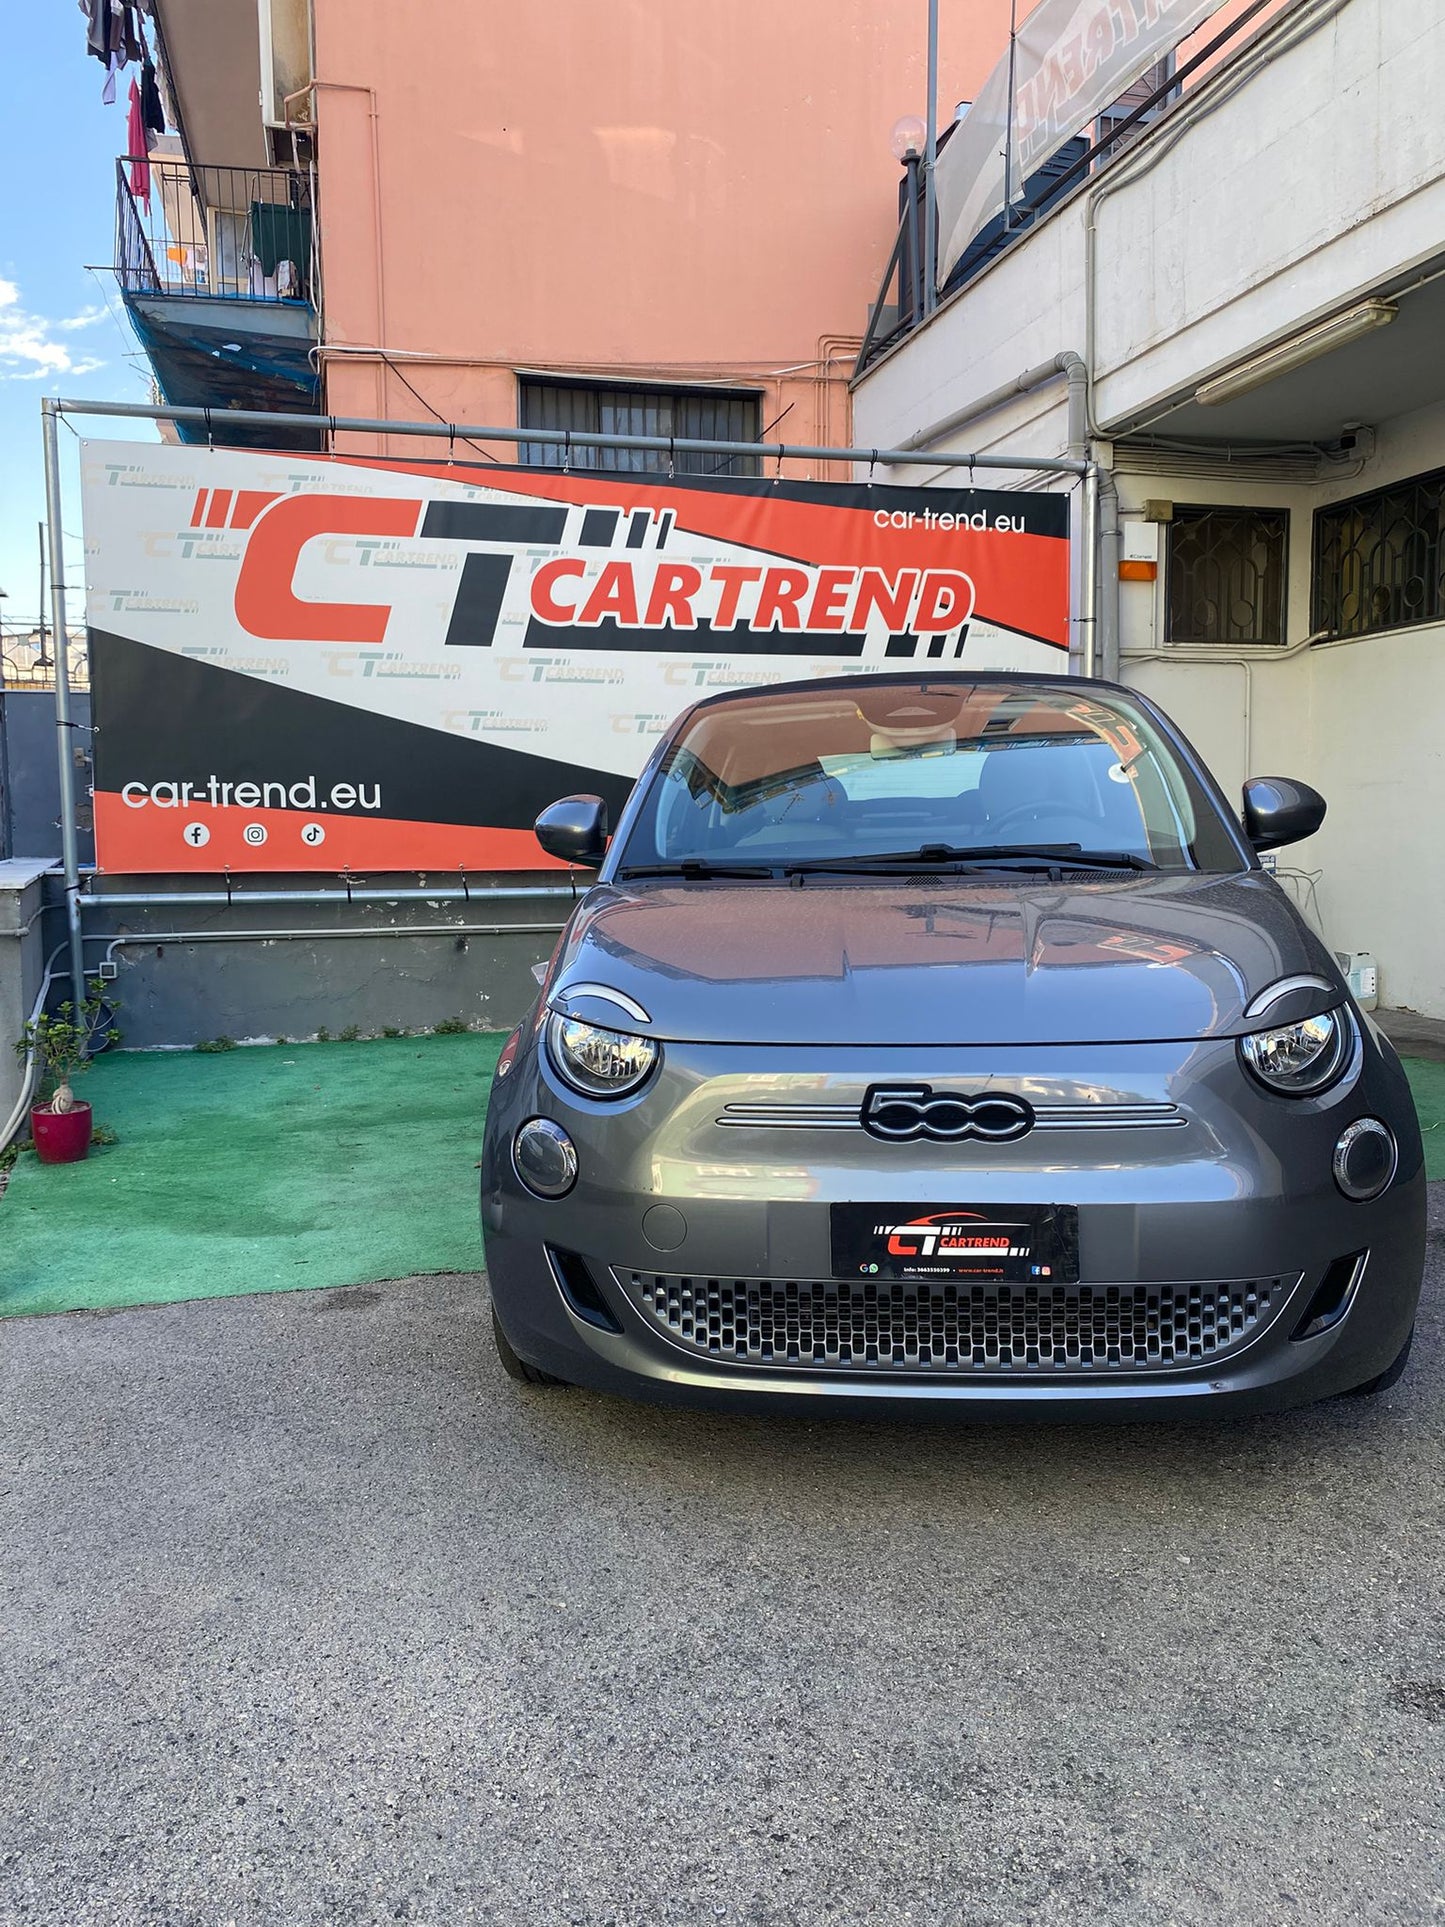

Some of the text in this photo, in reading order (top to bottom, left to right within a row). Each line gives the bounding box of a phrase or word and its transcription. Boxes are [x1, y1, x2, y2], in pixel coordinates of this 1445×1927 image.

[873, 507, 1026, 534] car-trend.eu
[374, 551, 458, 564] CARTREND
[530, 558, 974, 632] CARTREND
[376, 661, 461, 675] CARTREND
[546, 666, 624, 680] CARTREND
[708, 671, 782, 683] CARTREND
[121, 774, 382, 809] car-trend.eu
[866, 1088, 1030, 1139] 500
[940, 1237, 1010, 1248] CARTREND
